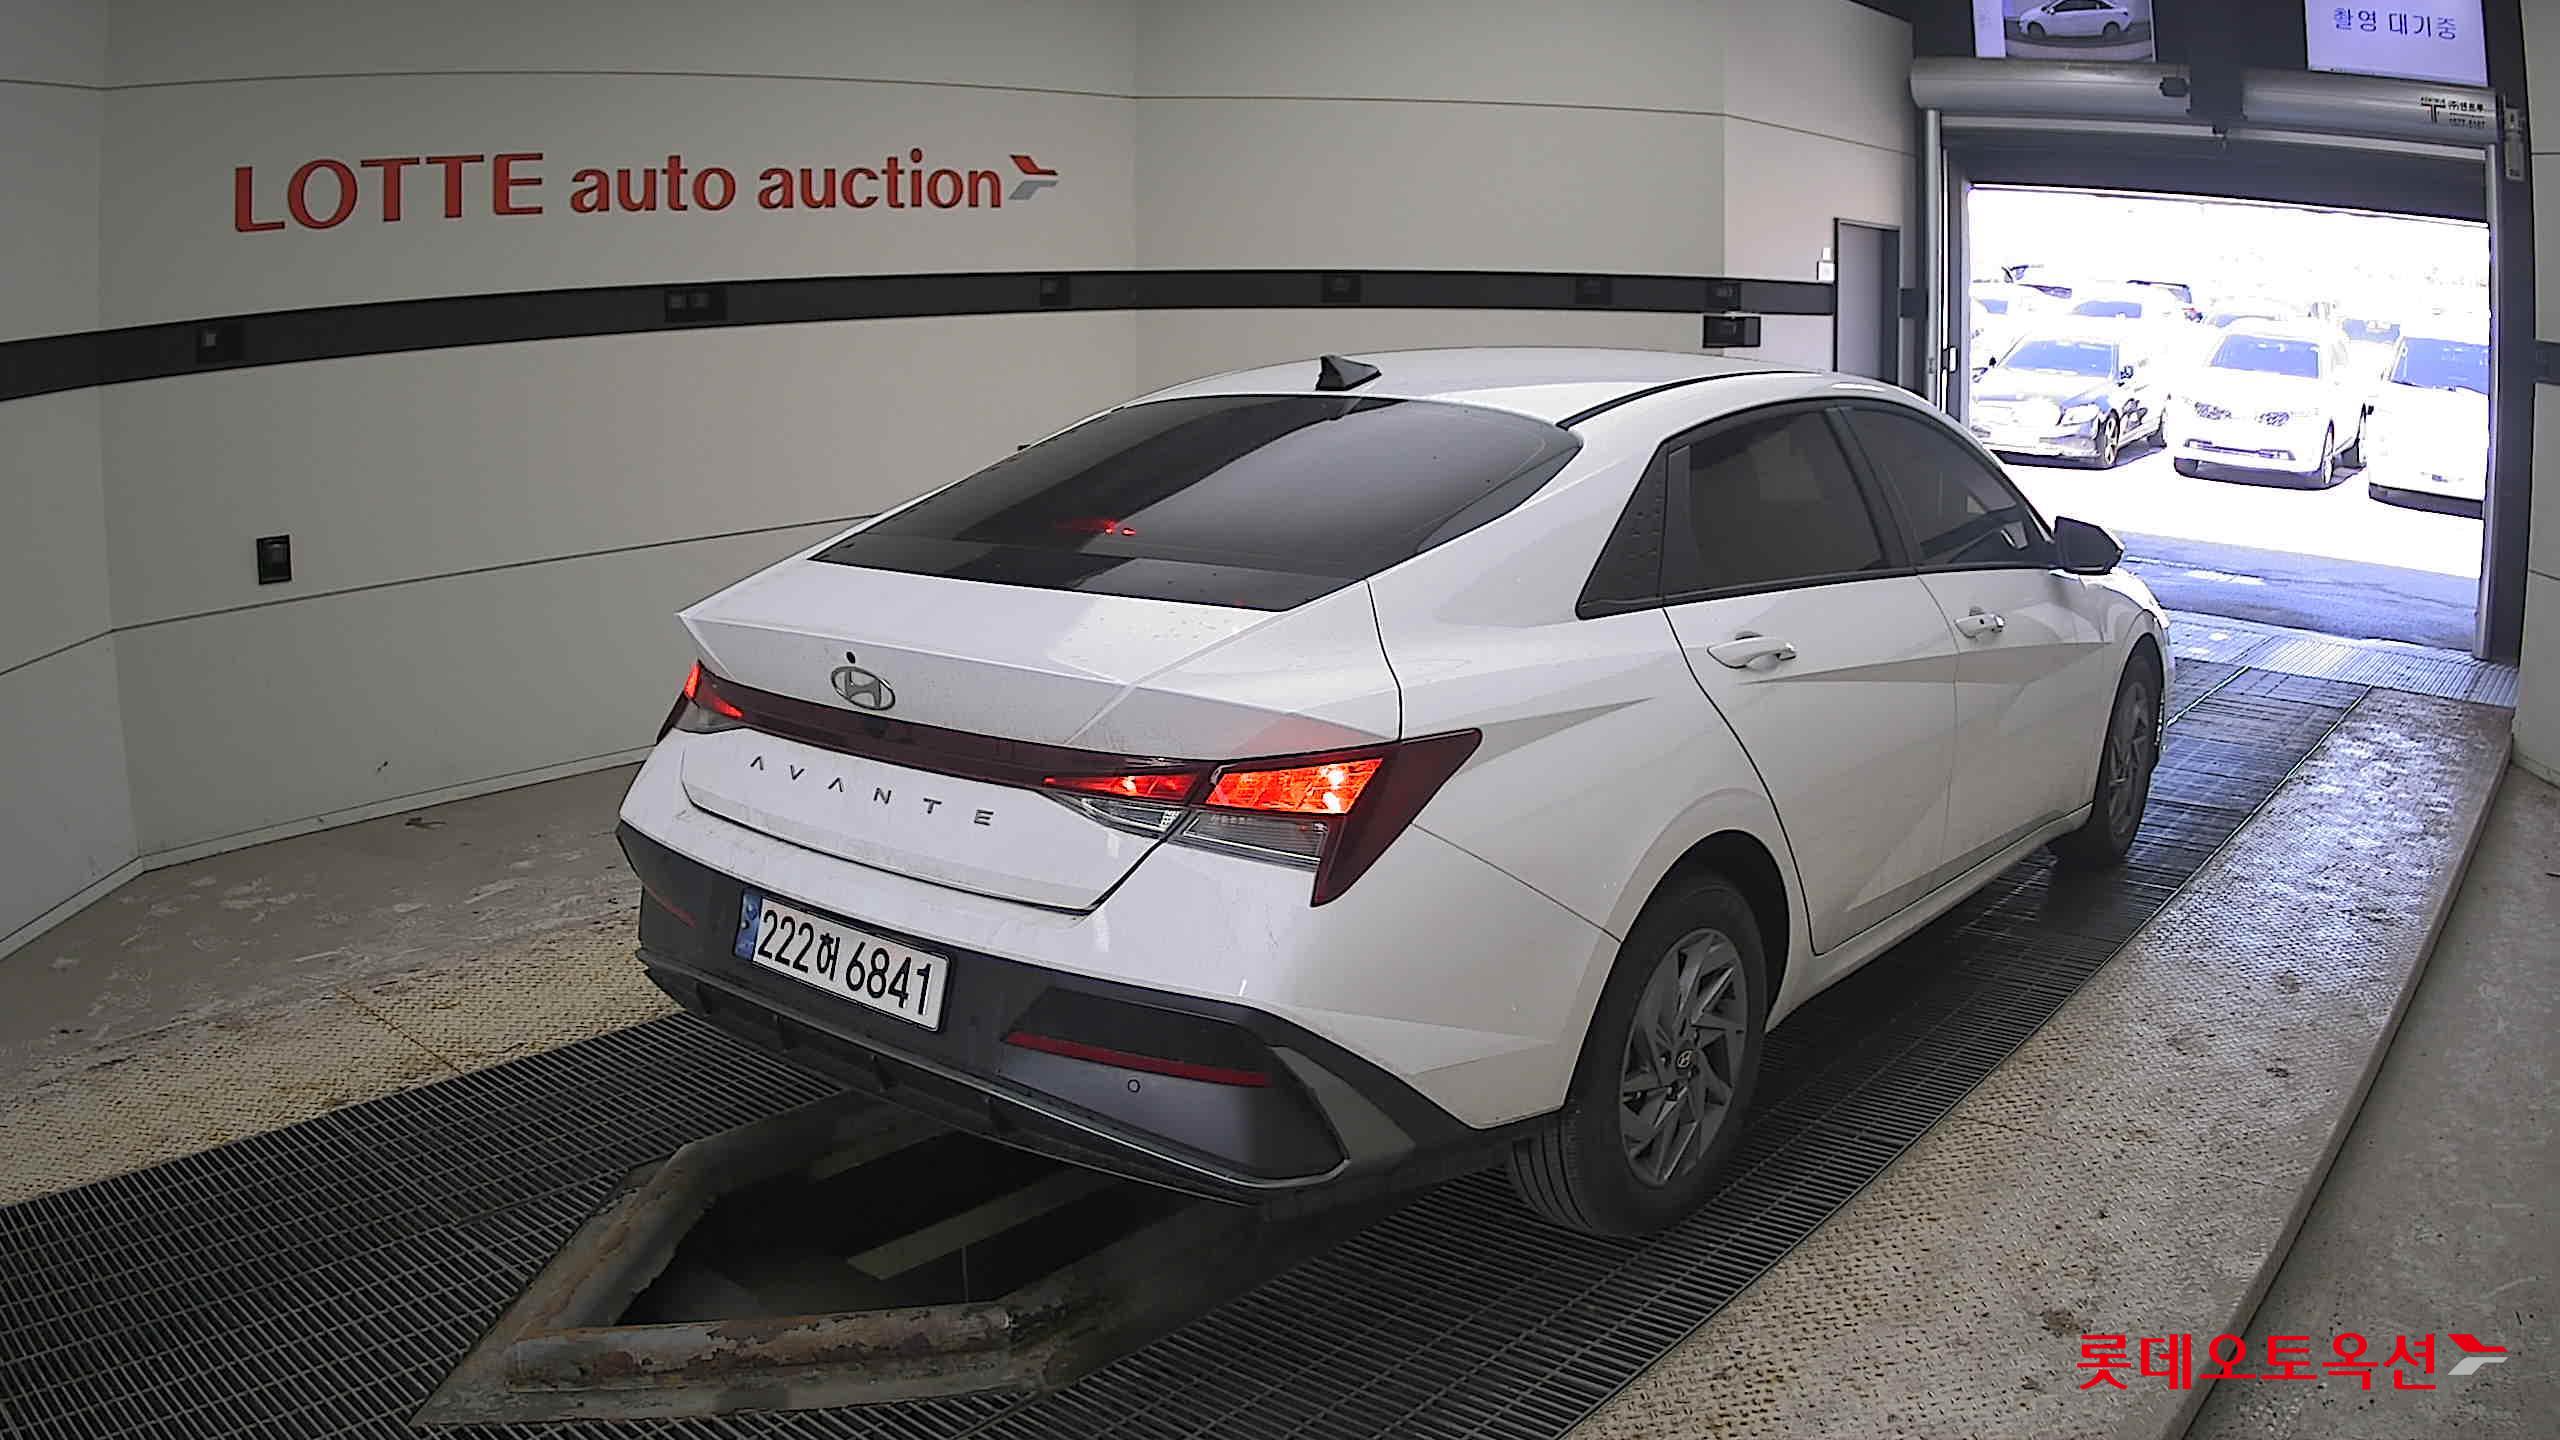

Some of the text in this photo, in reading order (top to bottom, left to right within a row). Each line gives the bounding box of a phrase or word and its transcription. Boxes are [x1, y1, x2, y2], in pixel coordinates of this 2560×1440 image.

[2334, 7, 2457, 41] 촬영 대기중
[234, 148, 1004, 233] LOTTE auto auction
[749, 755, 996, 827] AVANTE
[845, 941, 933, 1016] 6841
